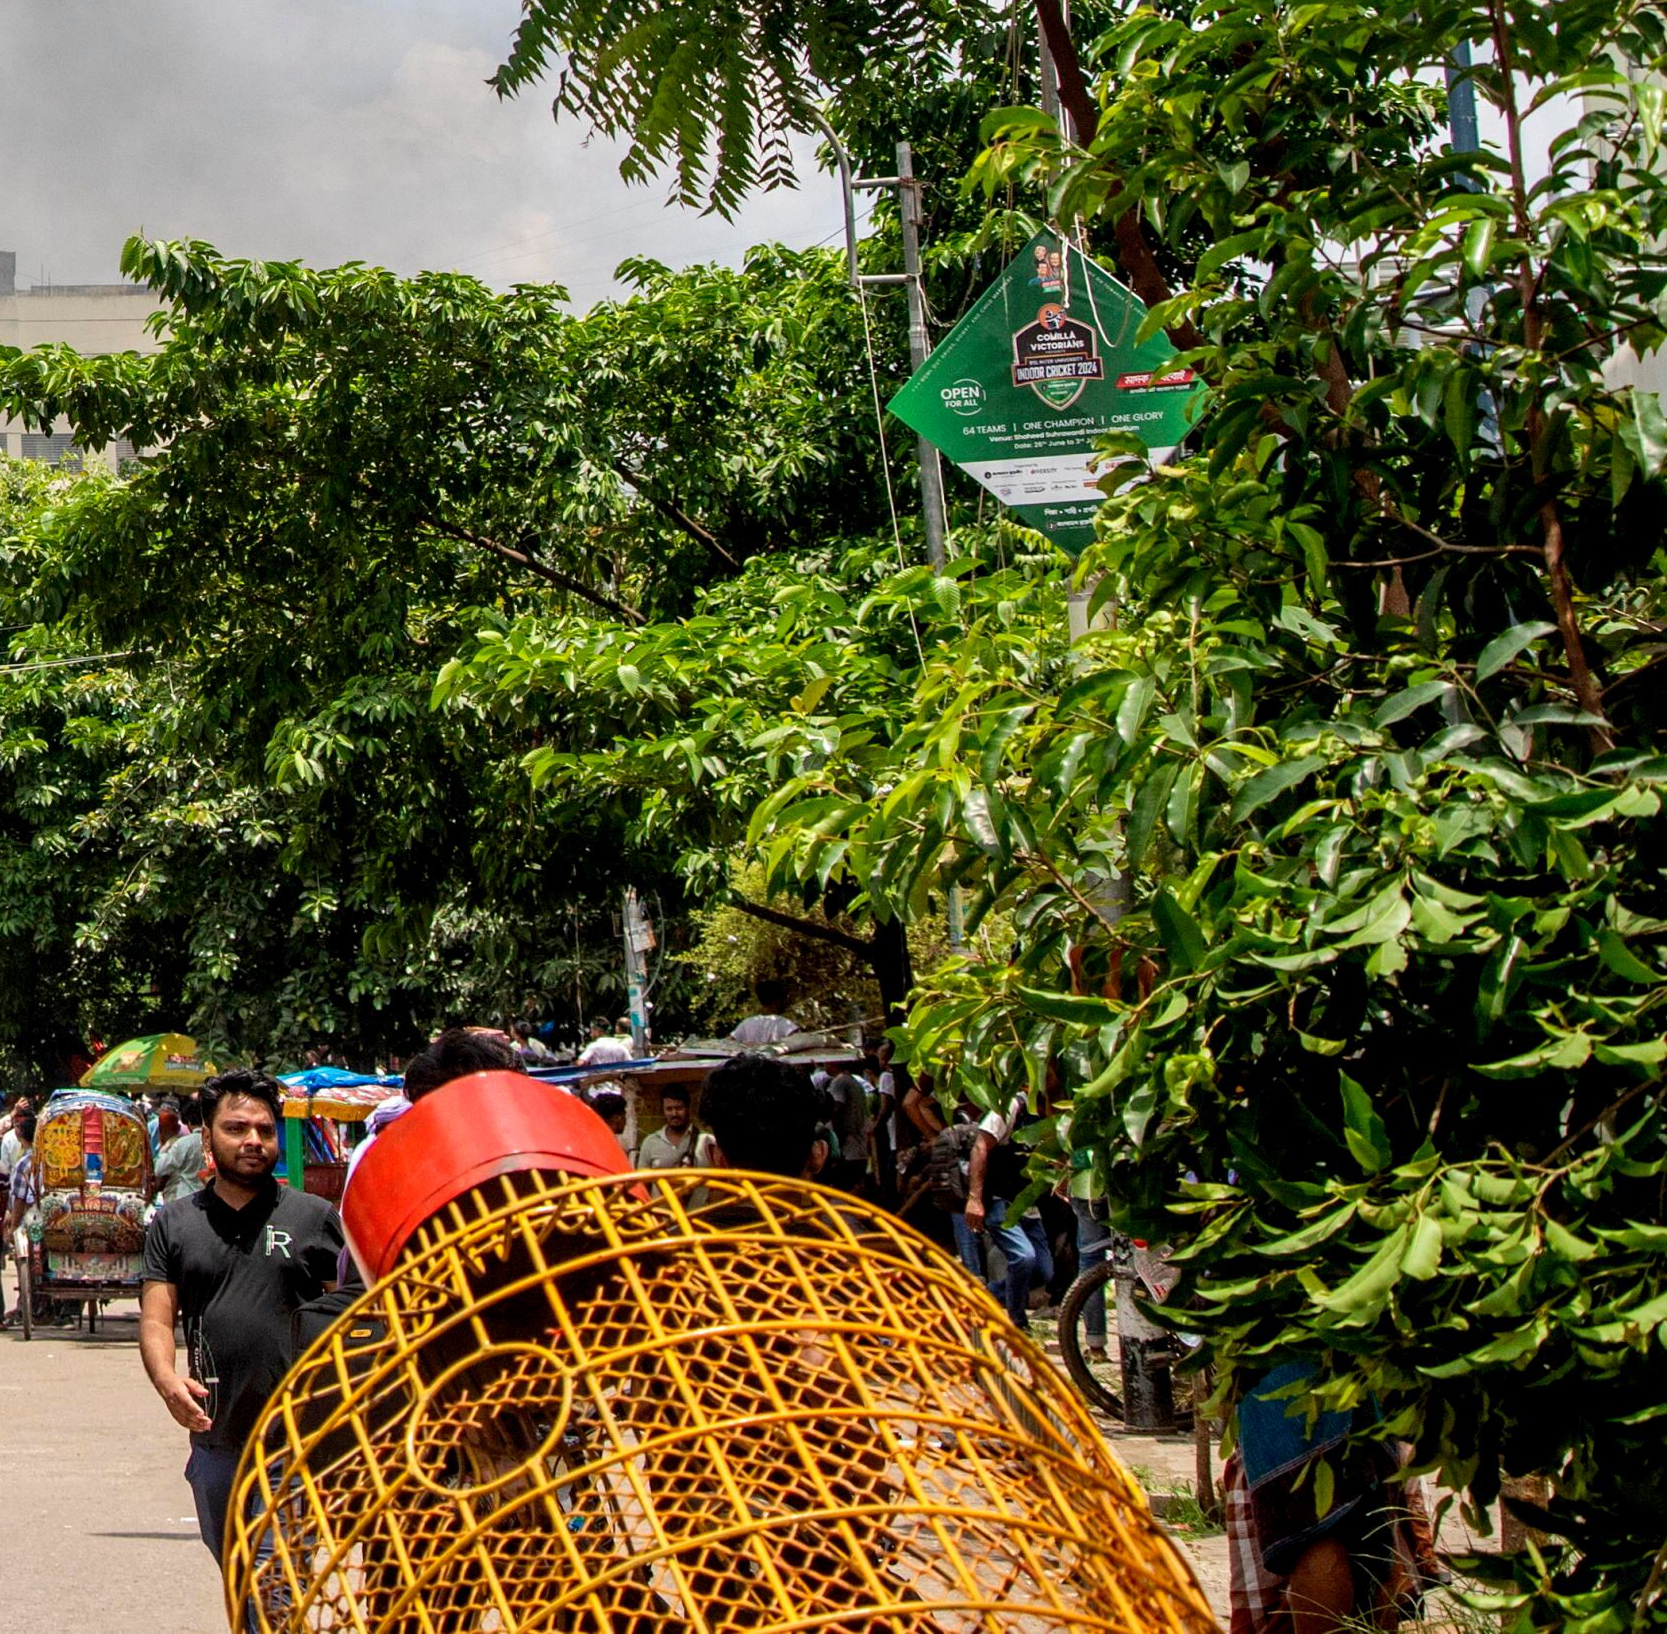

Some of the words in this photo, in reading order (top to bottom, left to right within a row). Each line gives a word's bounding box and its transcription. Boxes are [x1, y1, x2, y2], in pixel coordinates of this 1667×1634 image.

[1036, 330, 1076, 342] COMILLA
[1030, 340, 1085, 351] VICTORIANS
[1017, 367, 1045, 381] INDOOR
[1046, 363, 1076, 378] CRICKET
[1078, 362, 1098, 375] 2024
[940, 386, 979, 400] OPEN
[945, 400, 962, 408] FOR
[963, 426, 975, 435] 64
[976, 424, 1006, 434] TEAMS
[1023, 421, 1042, 430] ONE
[1044, 417, 1094, 429] CHAMPION
[1111, 414, 1131, 423] ONE
[1132, 411, 1164, 421] GLORY
